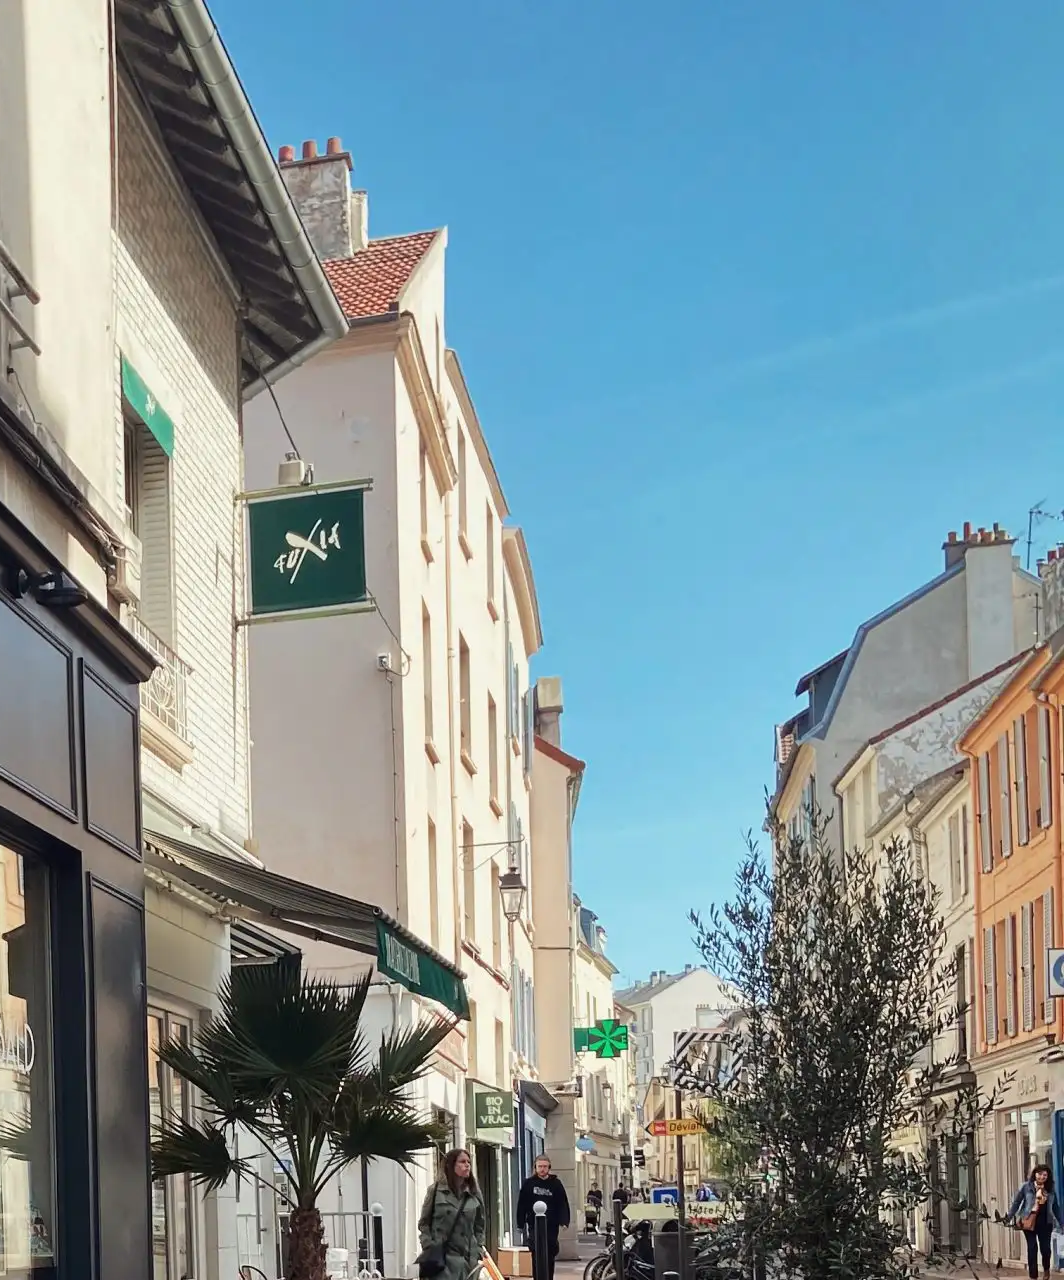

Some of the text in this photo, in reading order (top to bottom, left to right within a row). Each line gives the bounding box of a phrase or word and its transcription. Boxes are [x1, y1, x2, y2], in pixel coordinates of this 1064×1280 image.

[485, 1096, 503, 1106] BIO
[487, 1105, 501, 1115] EN
[480, 1114, 510, 1124] VRAC
